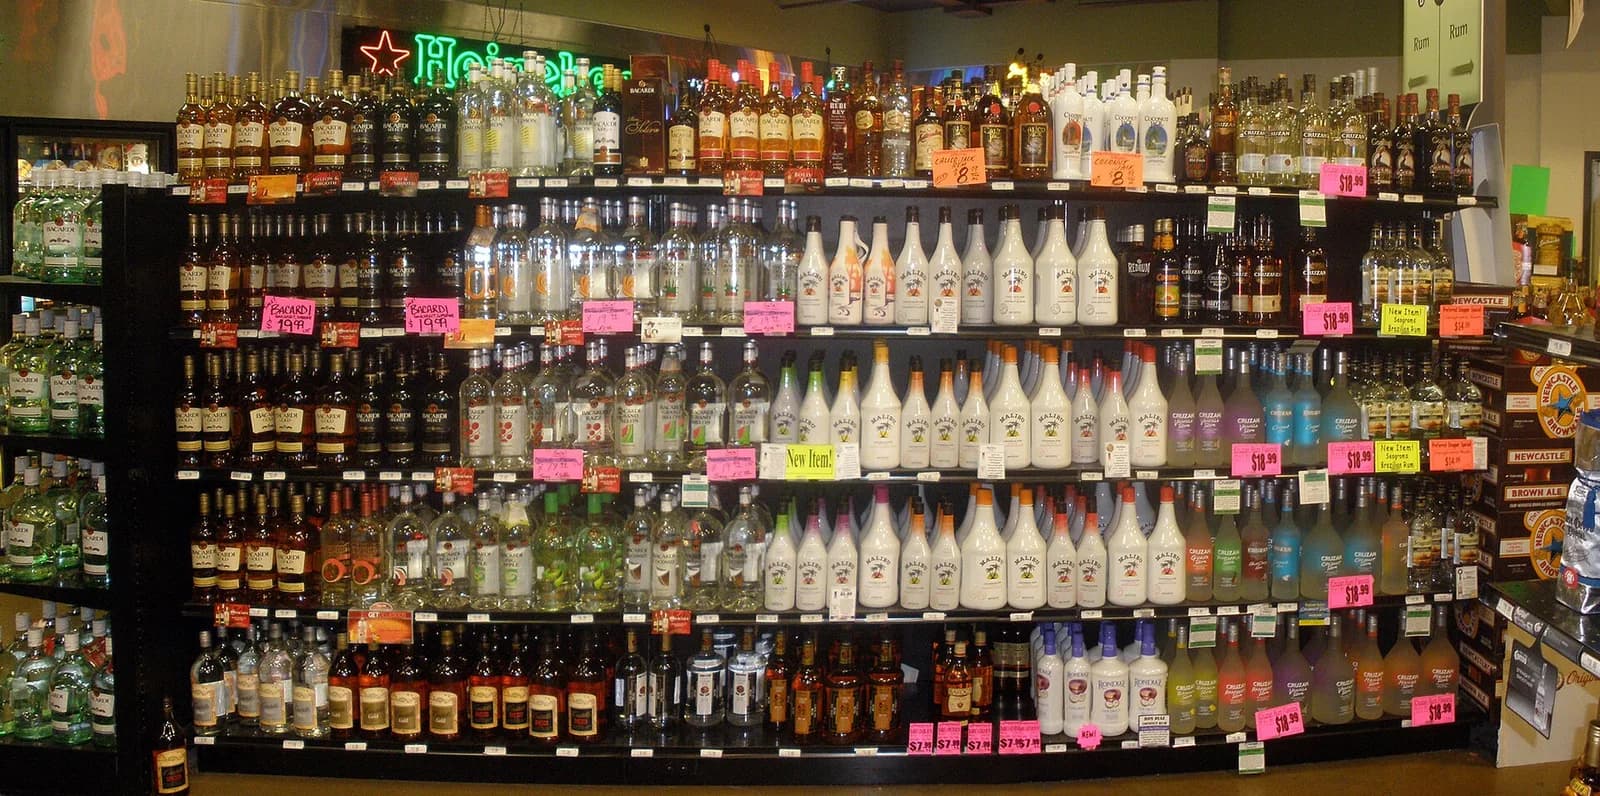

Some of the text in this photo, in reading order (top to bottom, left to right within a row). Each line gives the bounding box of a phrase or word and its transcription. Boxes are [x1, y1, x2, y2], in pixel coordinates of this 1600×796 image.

[1449, 23, 1468, 40] Rum
[1413, 36, 1430, 52] Rum
[414, 34, 632, 97] Heieke
[957, 166, 968, 183] 8
[1113, 171, 1123, 186] 8
[1340, 174, 1363, 192] $18.99
[1127, 262, 1150, 274] REDRUM
[799, 270, 823, 282] MALIBU
[900, 269, 927, 281] MALIBU
[934, 269, 960, 281] MALIBU
[1002, 268, 1029, 279] MALIBU
[1088, 269, 1114, 280] MALIBU
[1451, 297, 1504, 305] NEWCASTLE
[271, 304, 311, 316] BACARDI
[410, 305, 448, 314] BACARDI
[1324, 313, 1349, 330] $18.99
[1542, 375, 1579, 403] NEWCASTLE
[773, 411, 796, 421] MALIBU
[870, 414, 897, 424] MALIBU
[1000, 413, 1025, 423] MALIBU
[1038, 413, 1064, 423] MALIBU
[1074, 413, 1097, 423] MALIBU
[1138, 413, 1163, 423] MALIBU
[833, 418, 857, 428] MALIBU
[906, 418, 929, 428] MALIBU
[933, 417, 958, 428] MALIBU
[962, 418, 985, 428] MALIBU
[787, 449, 805, 468] New
[809, 448, 832, 468] Item!
[1348, 451, 1371, 469] $18.99
[1514, 452, 1565, 461] NEWCASTLE
[1251, 453, 1277, 471] $18.99
[1512, 488, 1561, 497] BROWN ALE
[866, 556, 891, 565] MALIBU
[1014, 556, 1040, 565] MALIBU
[1118, 554, 1143, 563] MALIBU
[1155, 553, 1180, 561] MALIBU
[768, 562, 790, 571] MALIBU
[799, 561, 821, 570] MALIBU
[831, 561, 855, 570] MALIBU
[904, 561, 928, 571] MALIBU
[934, 562, 958, 571] MALIBU
[1052, 560, 1075, 569] MALIBU
[1078, 559, 1101, 568] MALIBU
[1346, 584, 1369, 604] $18.99
[1429, 703, 1452, 721] $18.99
[1275, 712, 1299, 734] $18.99
